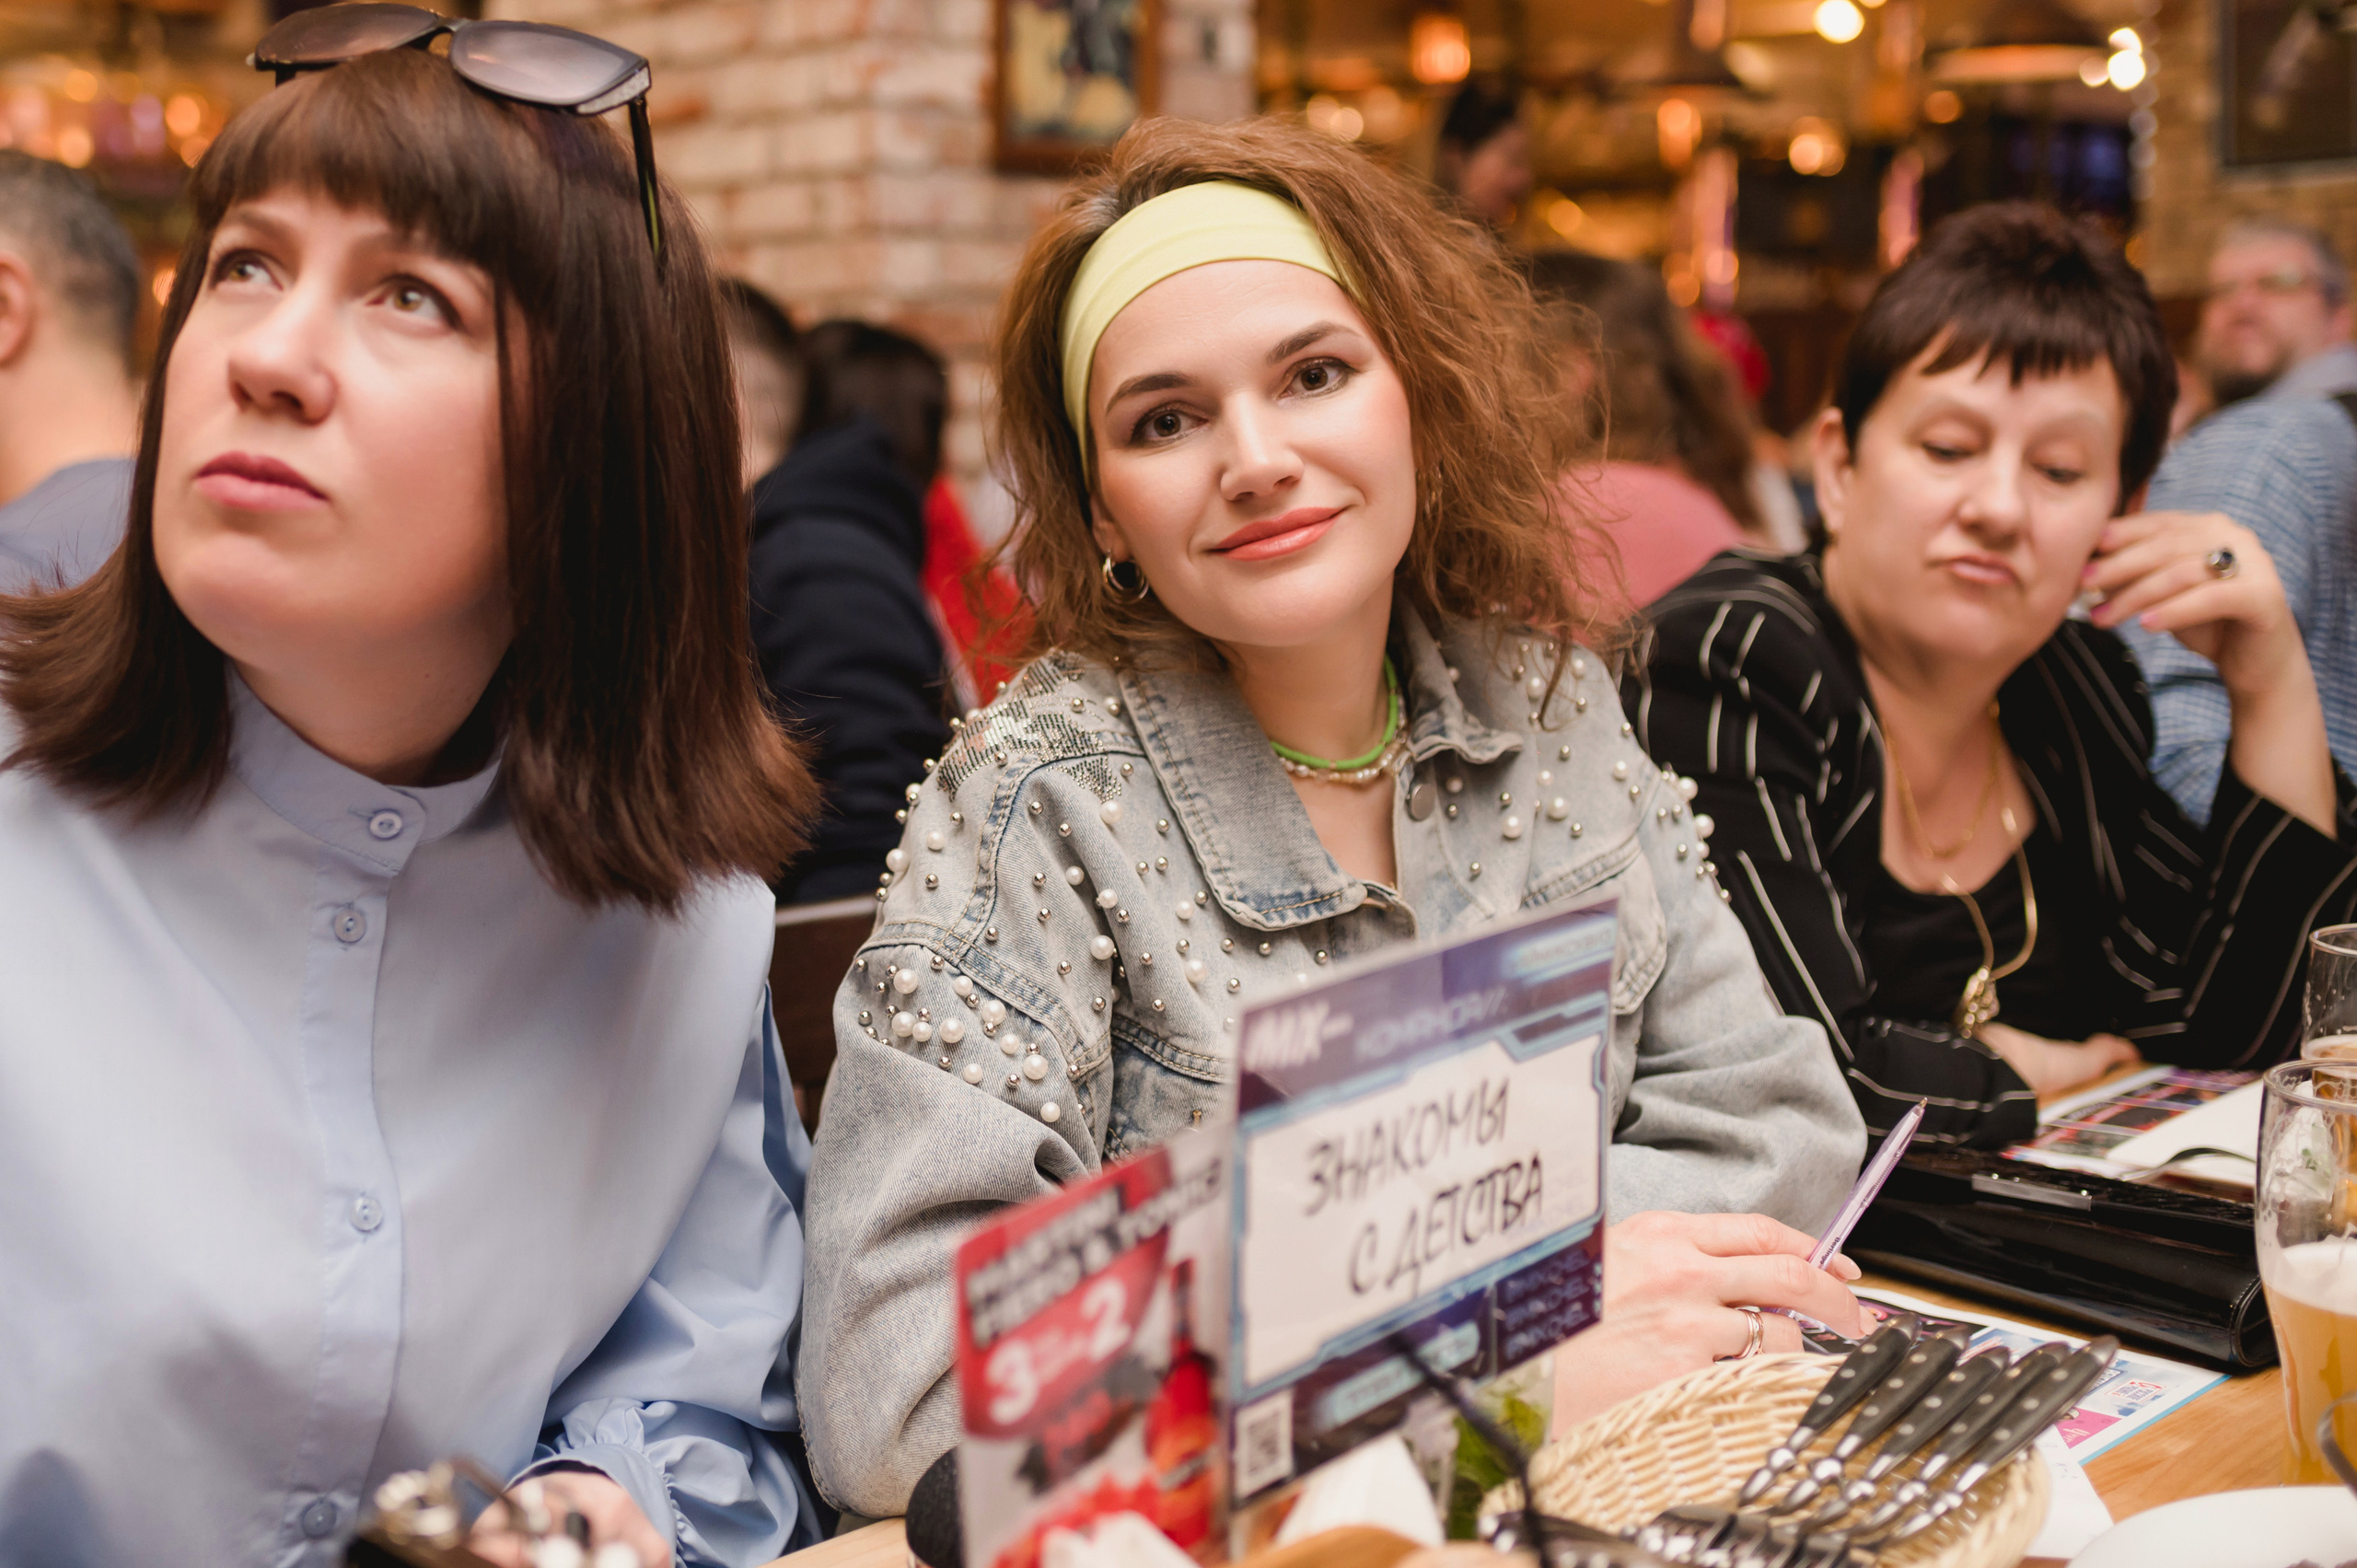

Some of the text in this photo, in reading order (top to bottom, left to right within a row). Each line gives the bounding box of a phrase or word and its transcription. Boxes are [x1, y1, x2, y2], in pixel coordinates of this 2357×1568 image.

[1304, 1076, 1510, 1216] ЗНАКОМЫ
[1384, 1148, 1544, 1299] ДЕТСТВА
[1819, 1236, 1840, 1265] Berlingo
[985, 1339, 1039, 1425] 3
[1080, 1277, 1133, 1361] 2
